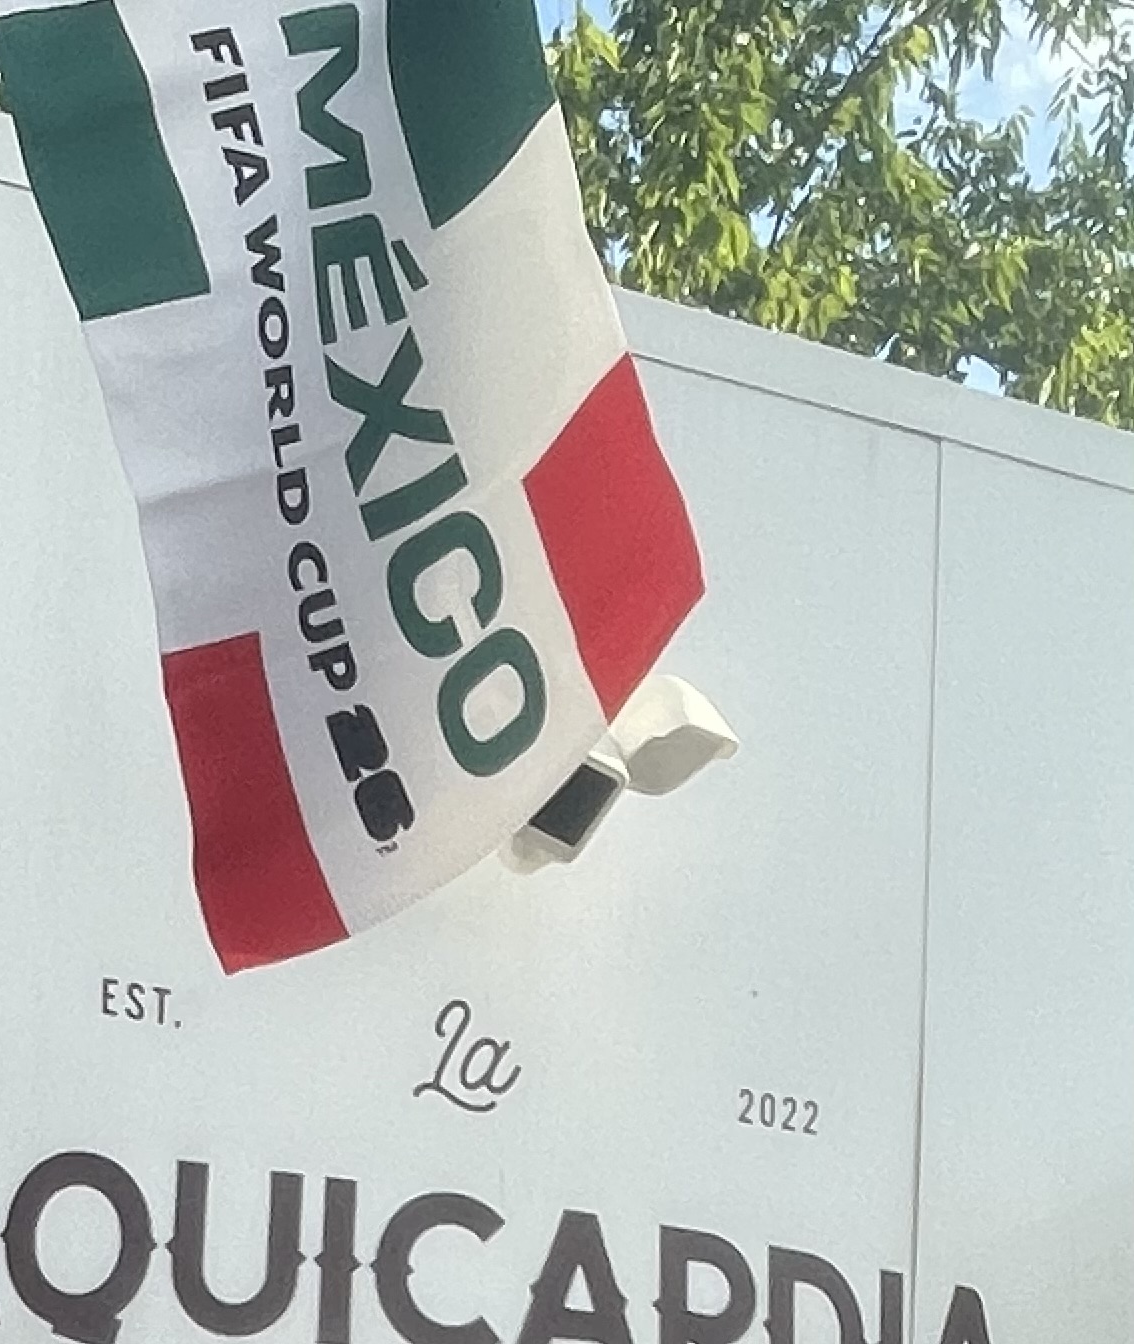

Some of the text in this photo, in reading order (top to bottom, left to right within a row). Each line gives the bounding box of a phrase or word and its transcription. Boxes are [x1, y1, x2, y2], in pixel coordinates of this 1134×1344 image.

[189, 26, 416, 842] FIFA WORLD CUP 26
[278, 3, 548, 777] MÉXICO
[102, 978, 183, 1028] EST.
[412, 999, 523, 1113] La
[738, 1088, 819, 1136] 2022
